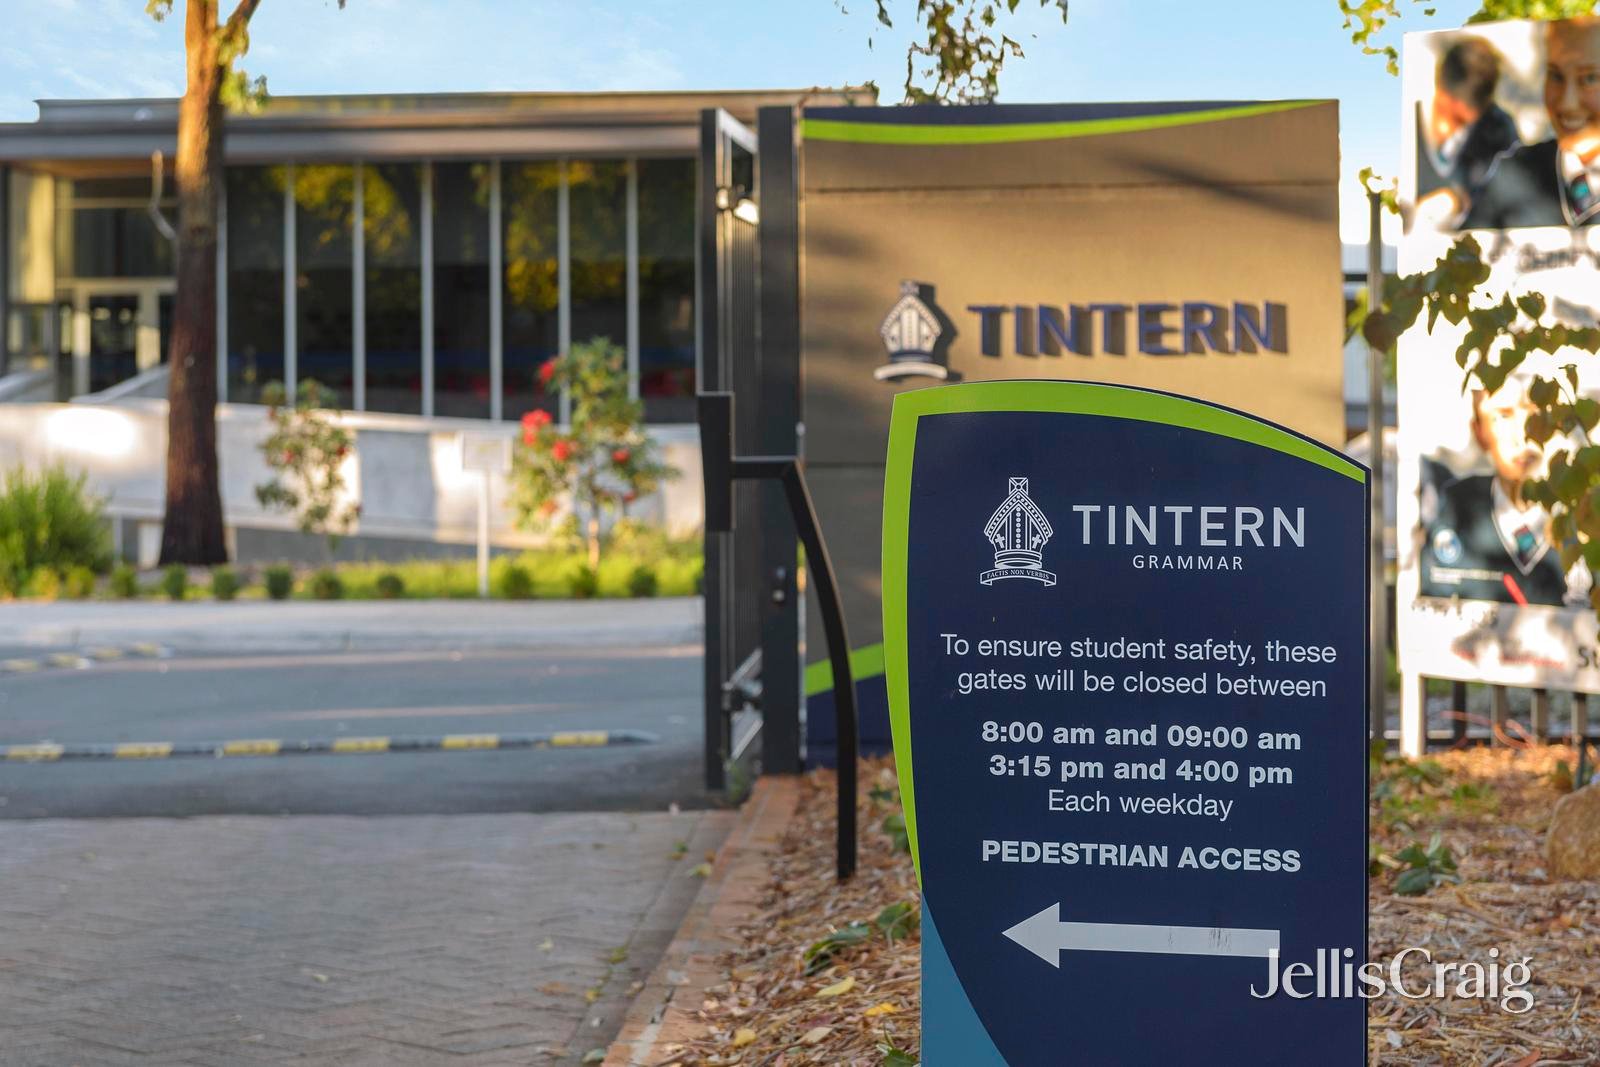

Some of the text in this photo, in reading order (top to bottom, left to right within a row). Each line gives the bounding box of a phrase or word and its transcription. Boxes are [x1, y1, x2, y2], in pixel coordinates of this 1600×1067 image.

[967, 301, 1279, 356] TINTERN
[1072, 504, 1305, 548] TINTERN
[986, 569, 1009, 579] FACTIS
[1132, 554, 1243, 571] GRAMMAR
[940, 633, 1337, 667] To ensure student safety, these
[957, 668, 1327, 697] gates will be closed between
[981, 720, 1301, 751] 8:00 am and 09:00 am
[989, 754, 1293, 788] 3:15 pm and 4:00 pm
[1048, 788, 1234, 822] Each weekday
[982, 839, 1302, 873] PEDESTRIAN ACCESS
